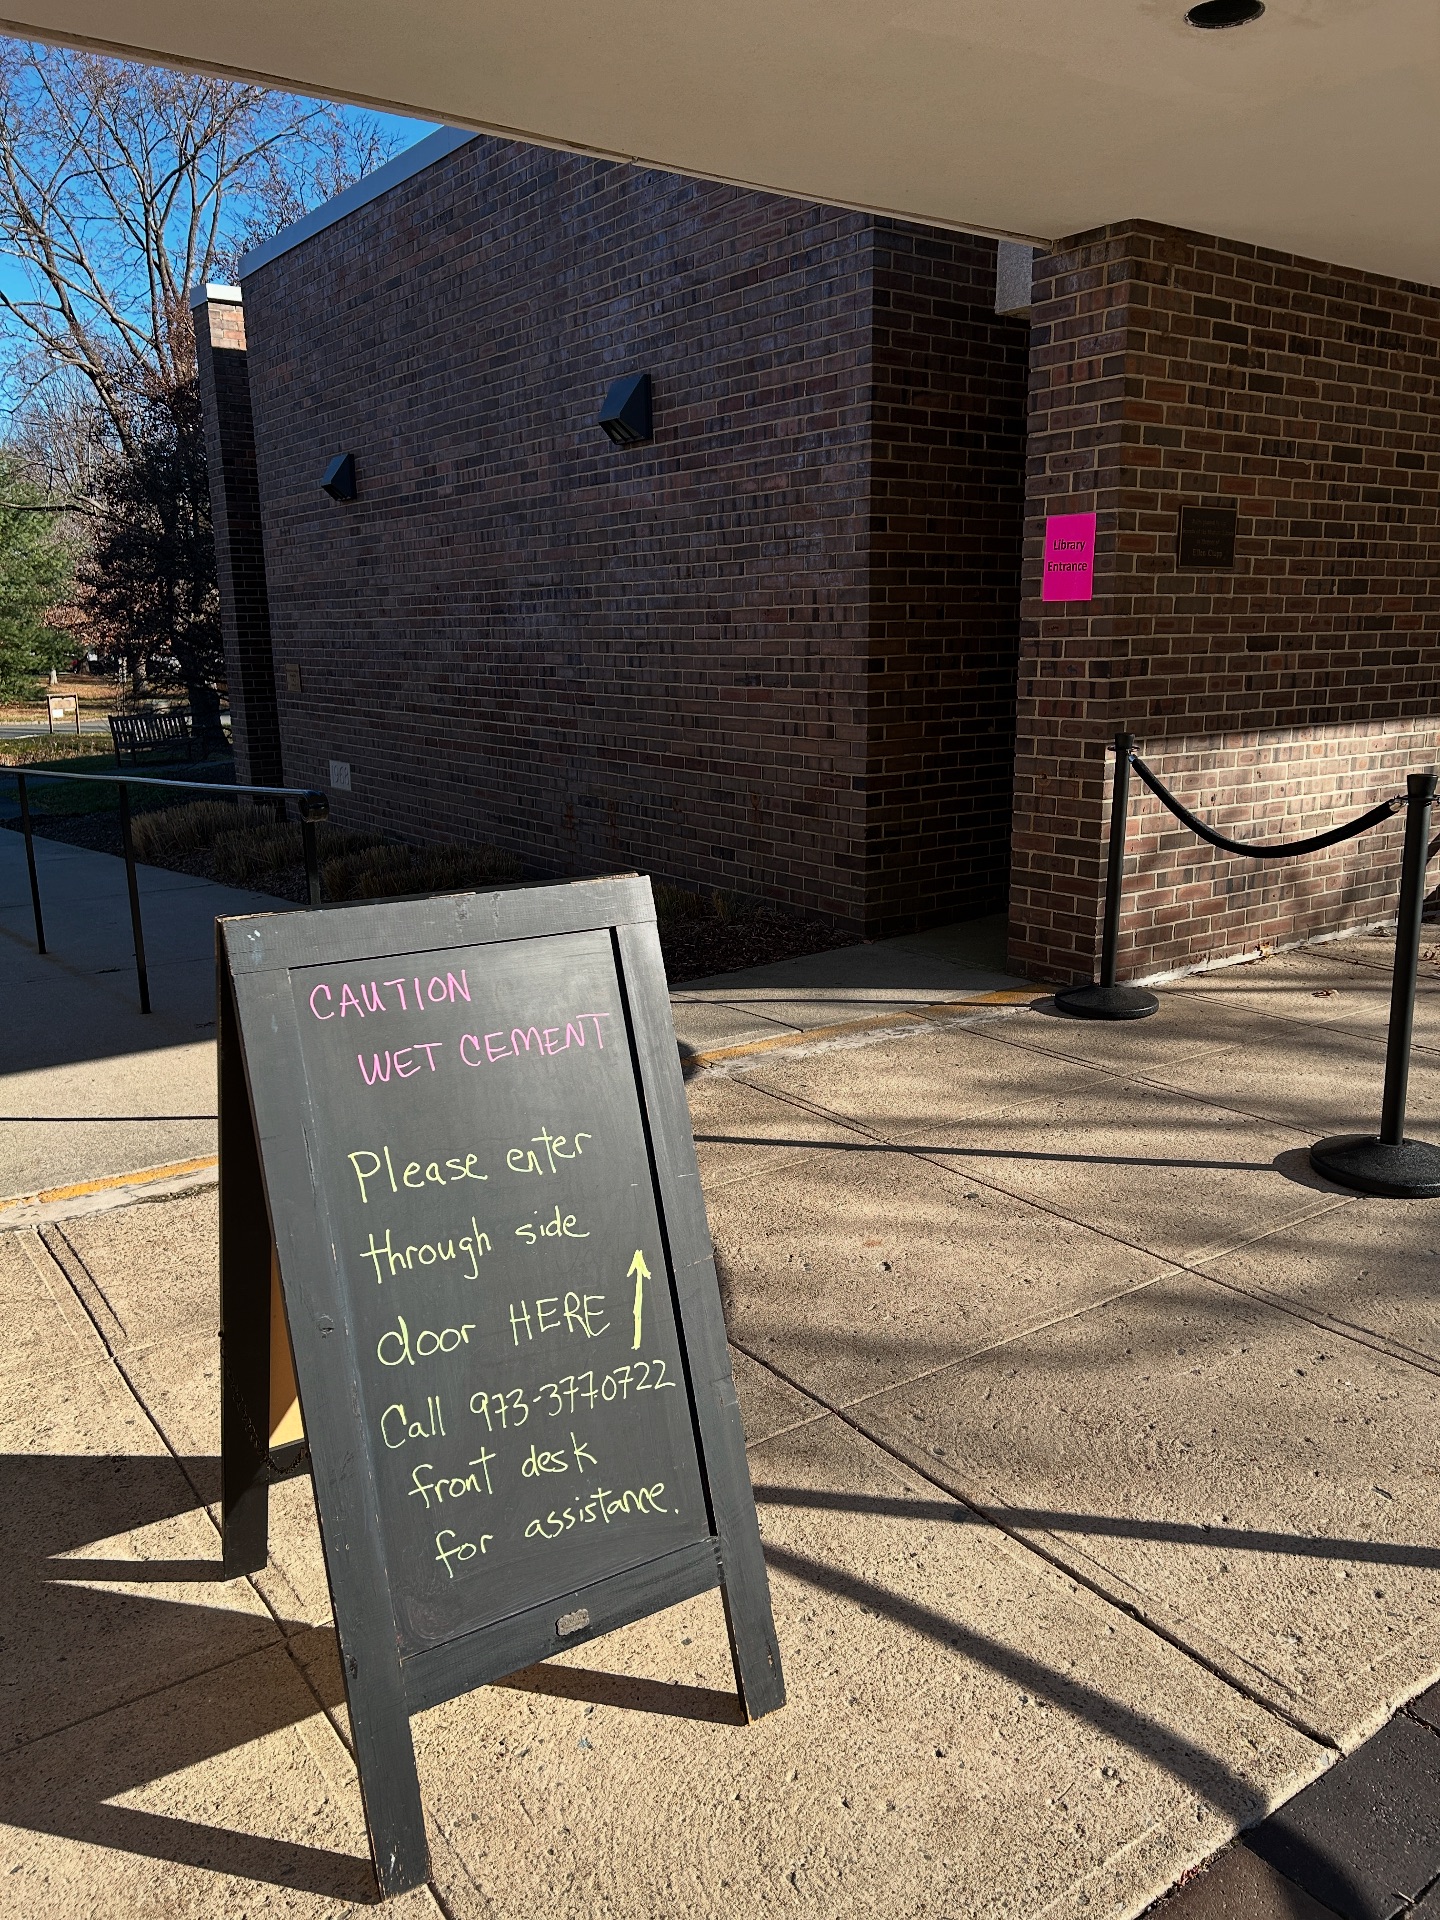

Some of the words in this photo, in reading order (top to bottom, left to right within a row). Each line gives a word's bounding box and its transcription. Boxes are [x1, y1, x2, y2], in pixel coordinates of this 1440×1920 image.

[1047, 561, 1088, 572] Entrance
[1053, 539, 1085, 552] Library
[309, 969, 471, 1020] CAUTION
[357, 1042, 442, 1085] WET
[459, 1013, 610, 1067] CEMENT
[347, 1146, 489, 1203] Please
[506, 1126, 592, 1175] enter
[360, 1216, 492, 1284] through
[515, 1205, 590, 1245] side
[377, 1315, 476, 1366] door
[509, 1291, 611, 1346] HERE
[380, 1395, 446, 1449] Call
[408, 1446, 496, 1509] front
[521, 1431, 597, 1477] desk
[435, 1529, 494, 1579] for
